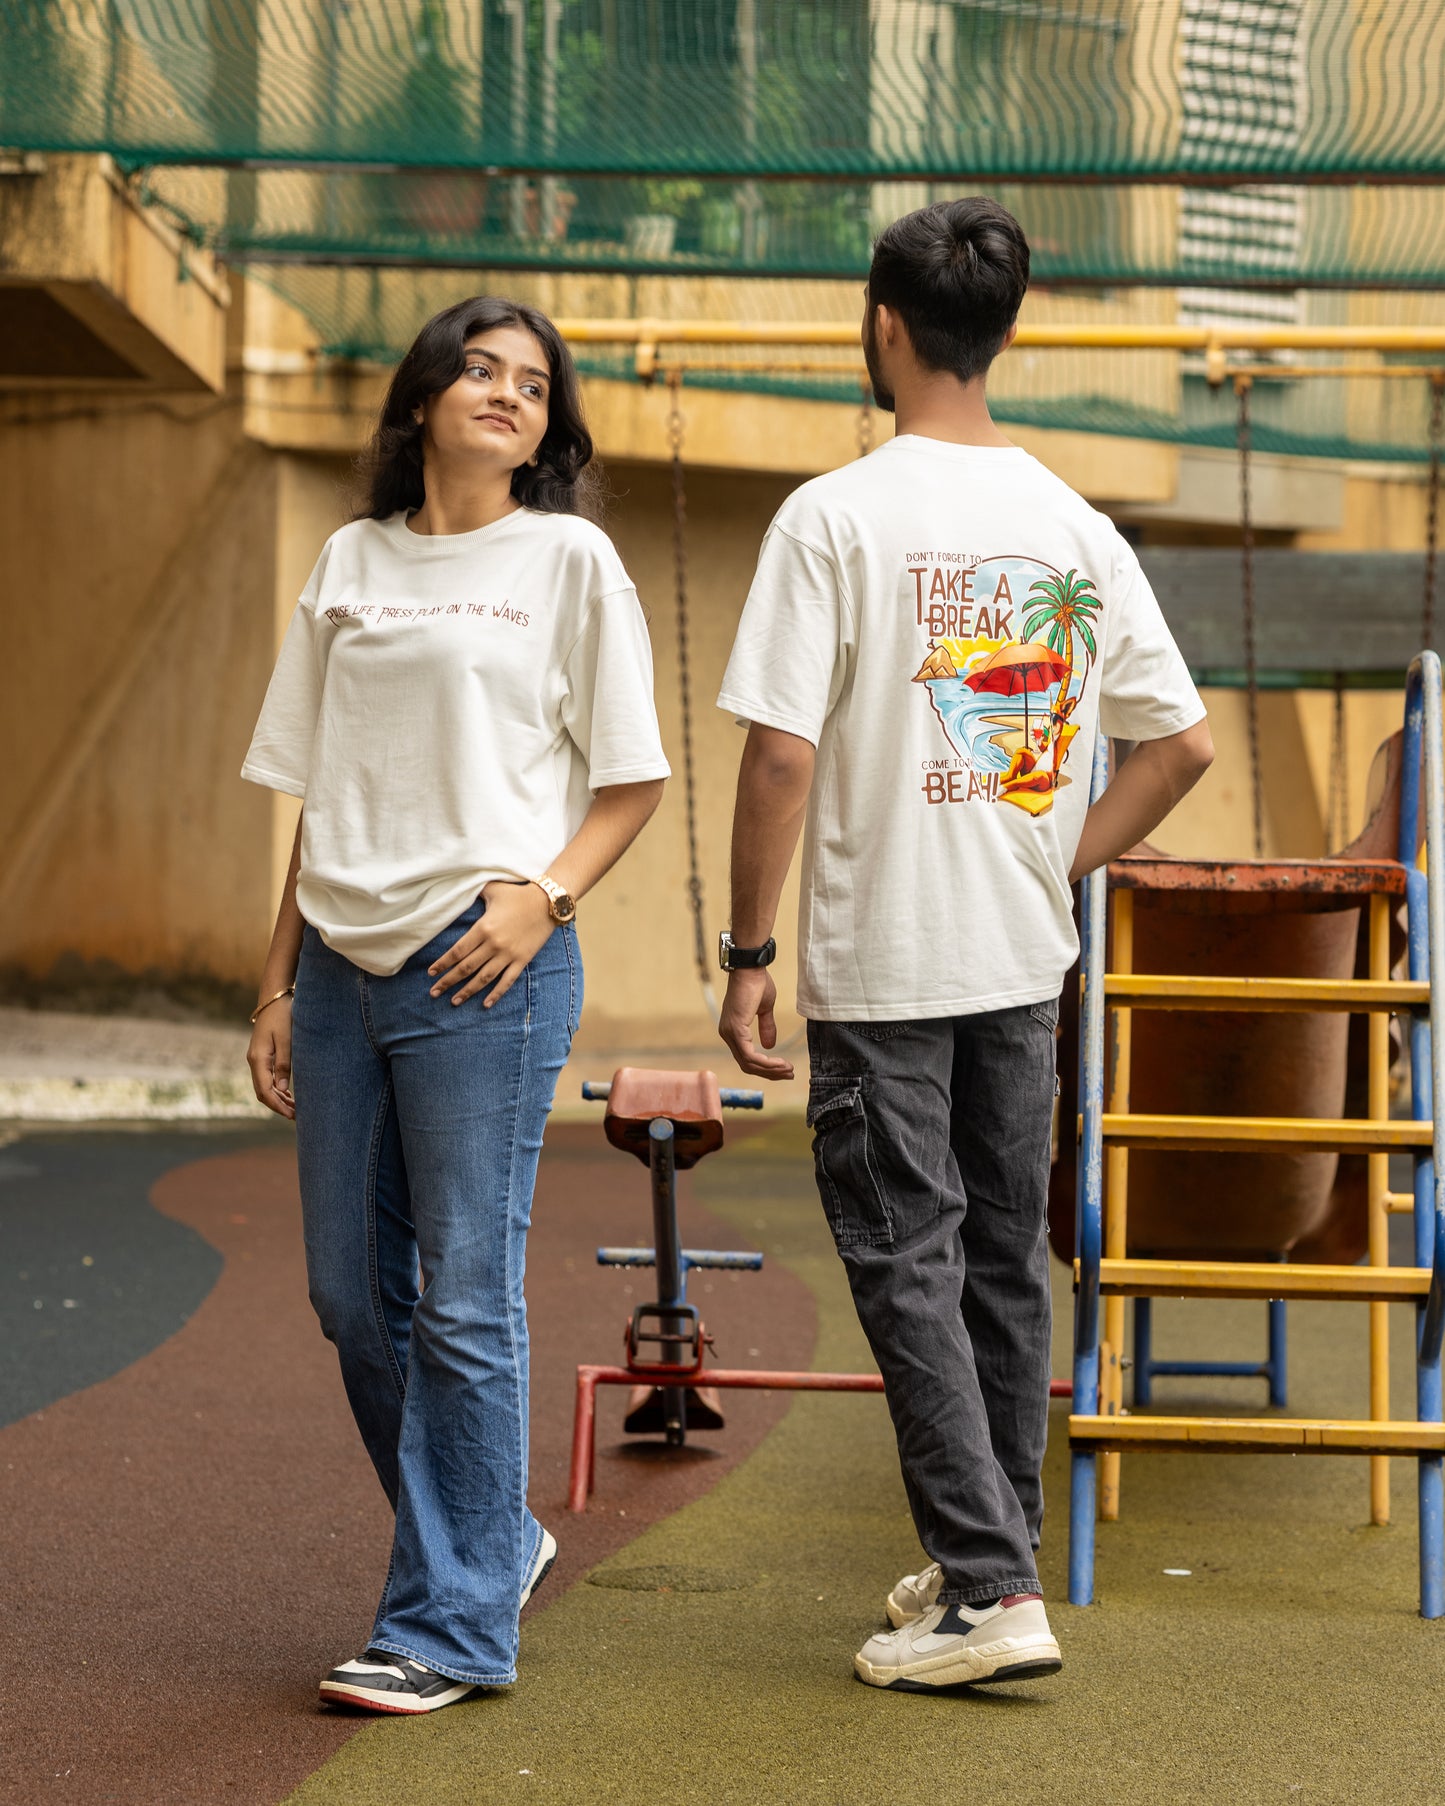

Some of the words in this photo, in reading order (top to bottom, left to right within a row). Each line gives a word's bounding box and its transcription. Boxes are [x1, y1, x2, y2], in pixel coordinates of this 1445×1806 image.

[905, 551, 934, 563] DON'T
[937, 551, 967, 564] FORGET
[970, 554, 982, 565] TO
[907, 567, 977, 626] TAKE
[992, 572, 1013, 606] A
[376, 606, 415, 625] PRESS
[411, 604, 446, 623] PLAY
[445, 603, 462, 615] ON
[466, 603, 487, 616] THE
[492, 599, 530, 628] WAVES
[923, 604, 1015, 641] BREAK
[921, 759, 950, 771] COME
[920, 769, 1000, 805] BEAH!
